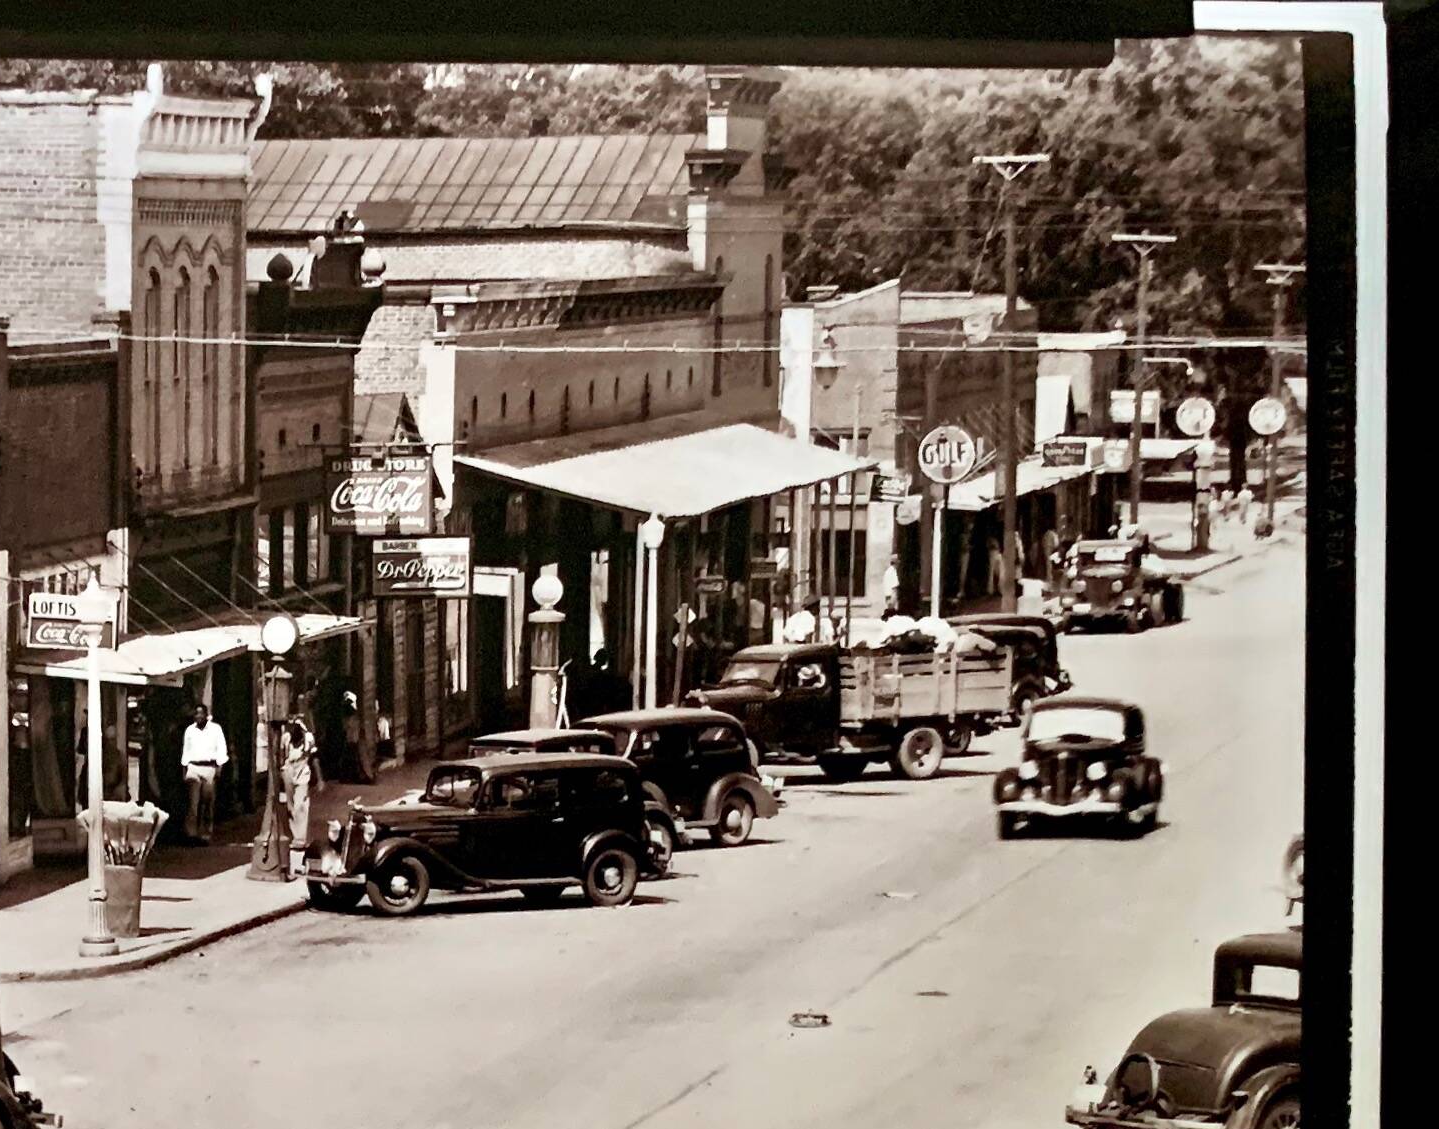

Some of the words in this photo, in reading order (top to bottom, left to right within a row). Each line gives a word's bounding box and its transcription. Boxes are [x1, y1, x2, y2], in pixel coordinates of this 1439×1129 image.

[922, 441, 967, 465] GULF
[331, 475, 427, 513] Coca-Cola
[32, 600, 77, 617] LOFTIS
